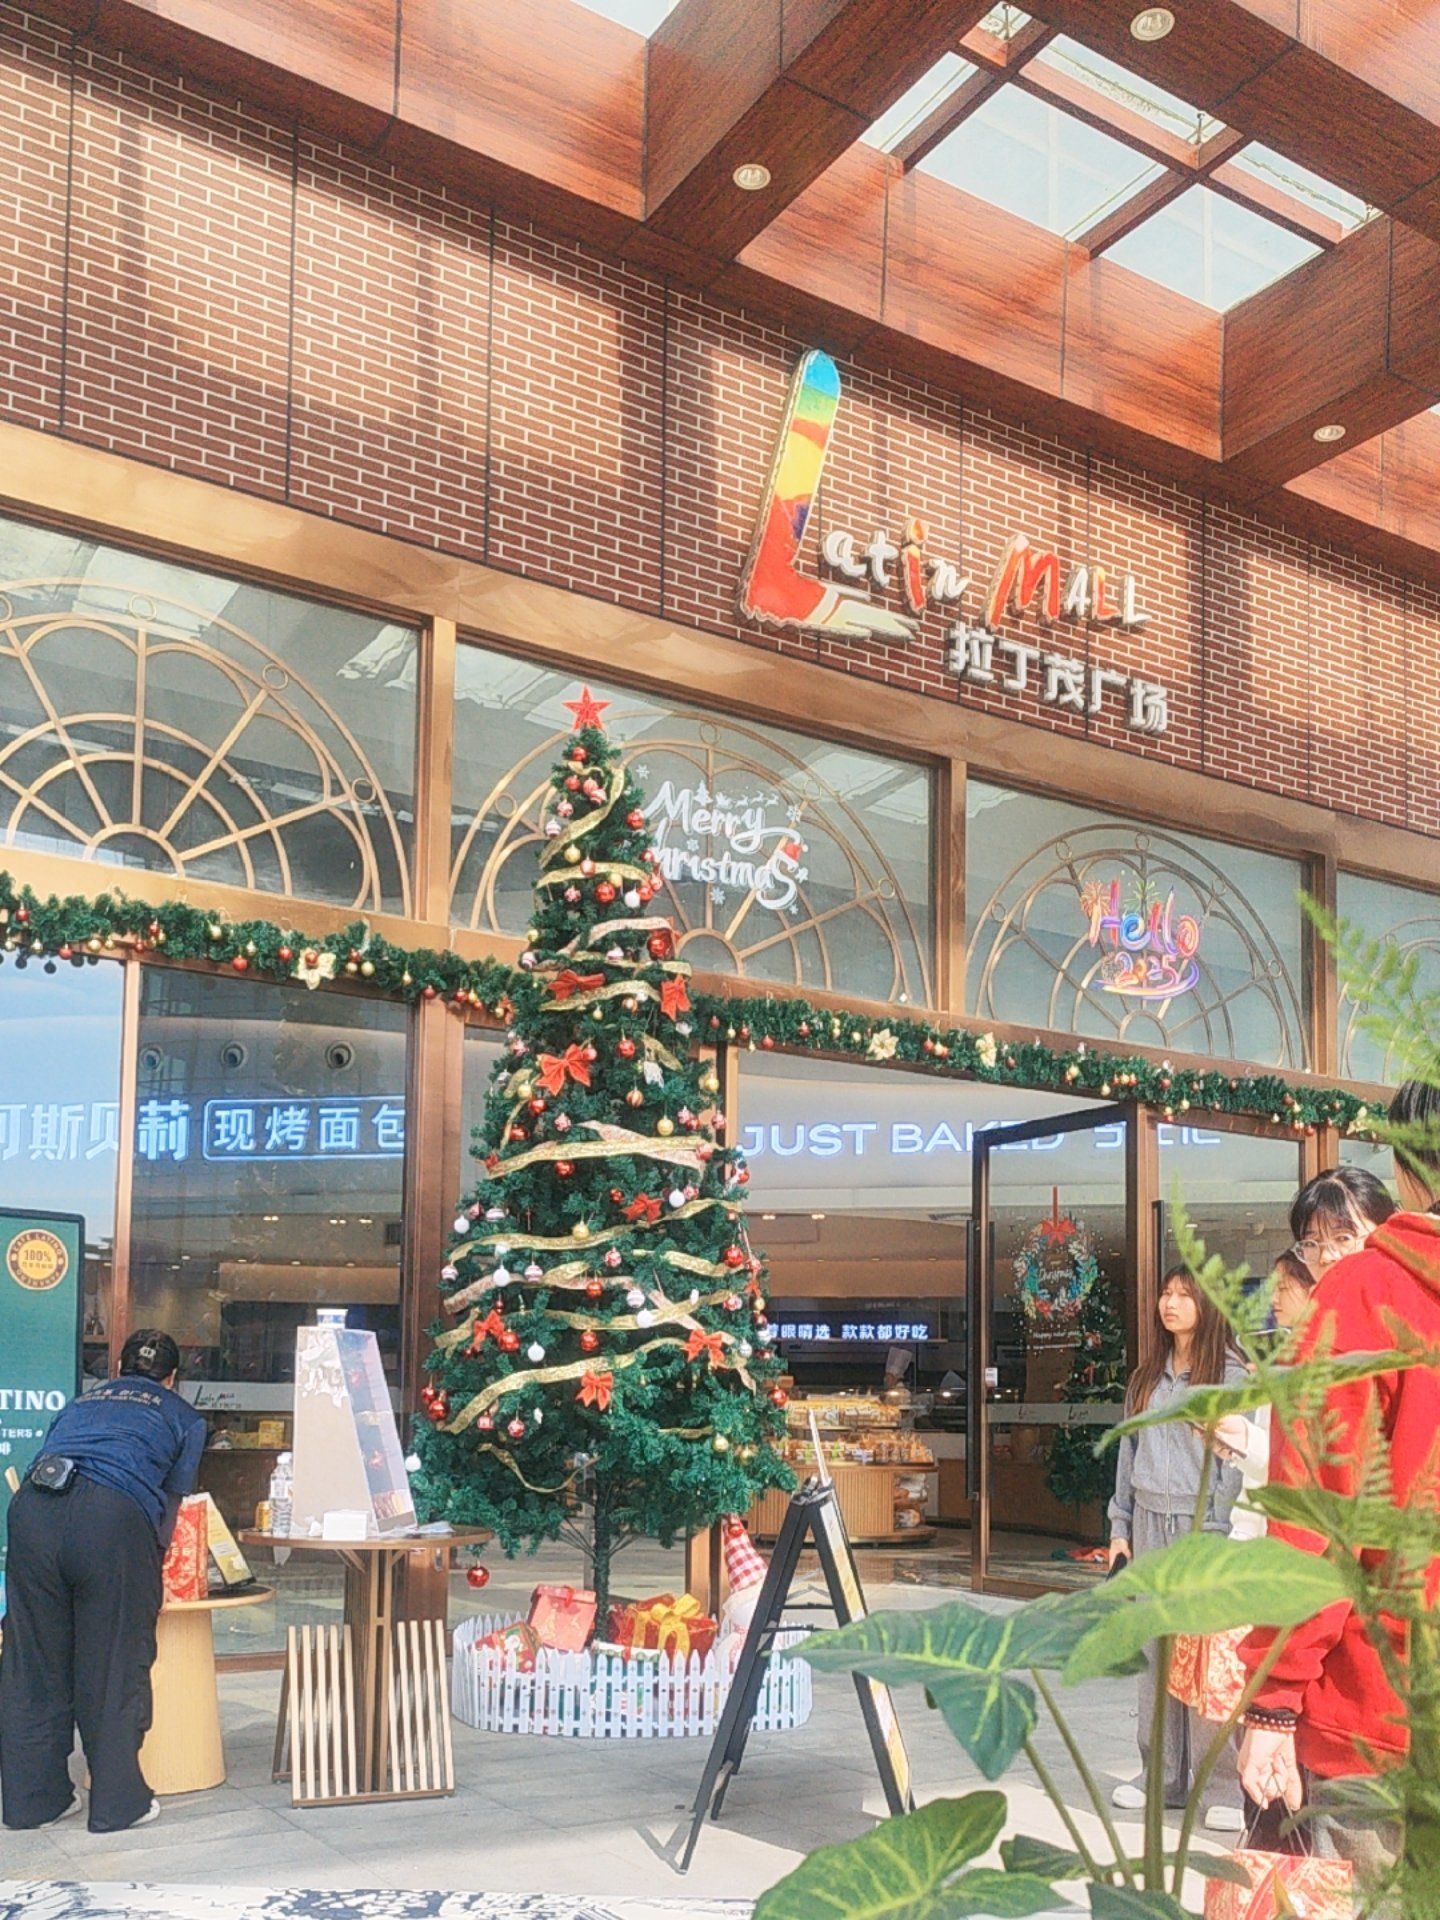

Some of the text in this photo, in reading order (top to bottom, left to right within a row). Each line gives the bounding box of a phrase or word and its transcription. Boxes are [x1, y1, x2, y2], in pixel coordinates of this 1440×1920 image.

[741, 349, 1151, 642] Latin MALL
[946, 622, 1168, 734] 拉丁茂广场
[641, 781, 804, 855] Merry
[1088, 879, 1199, 958] Hello
[1114, 951, 1181, 989] 2025
[213, 1103, 405, 1151] 现烤面包
[737, 1123, 877, 1156] JUST
[842, 1323, 928, 1340] 款款都好吃
